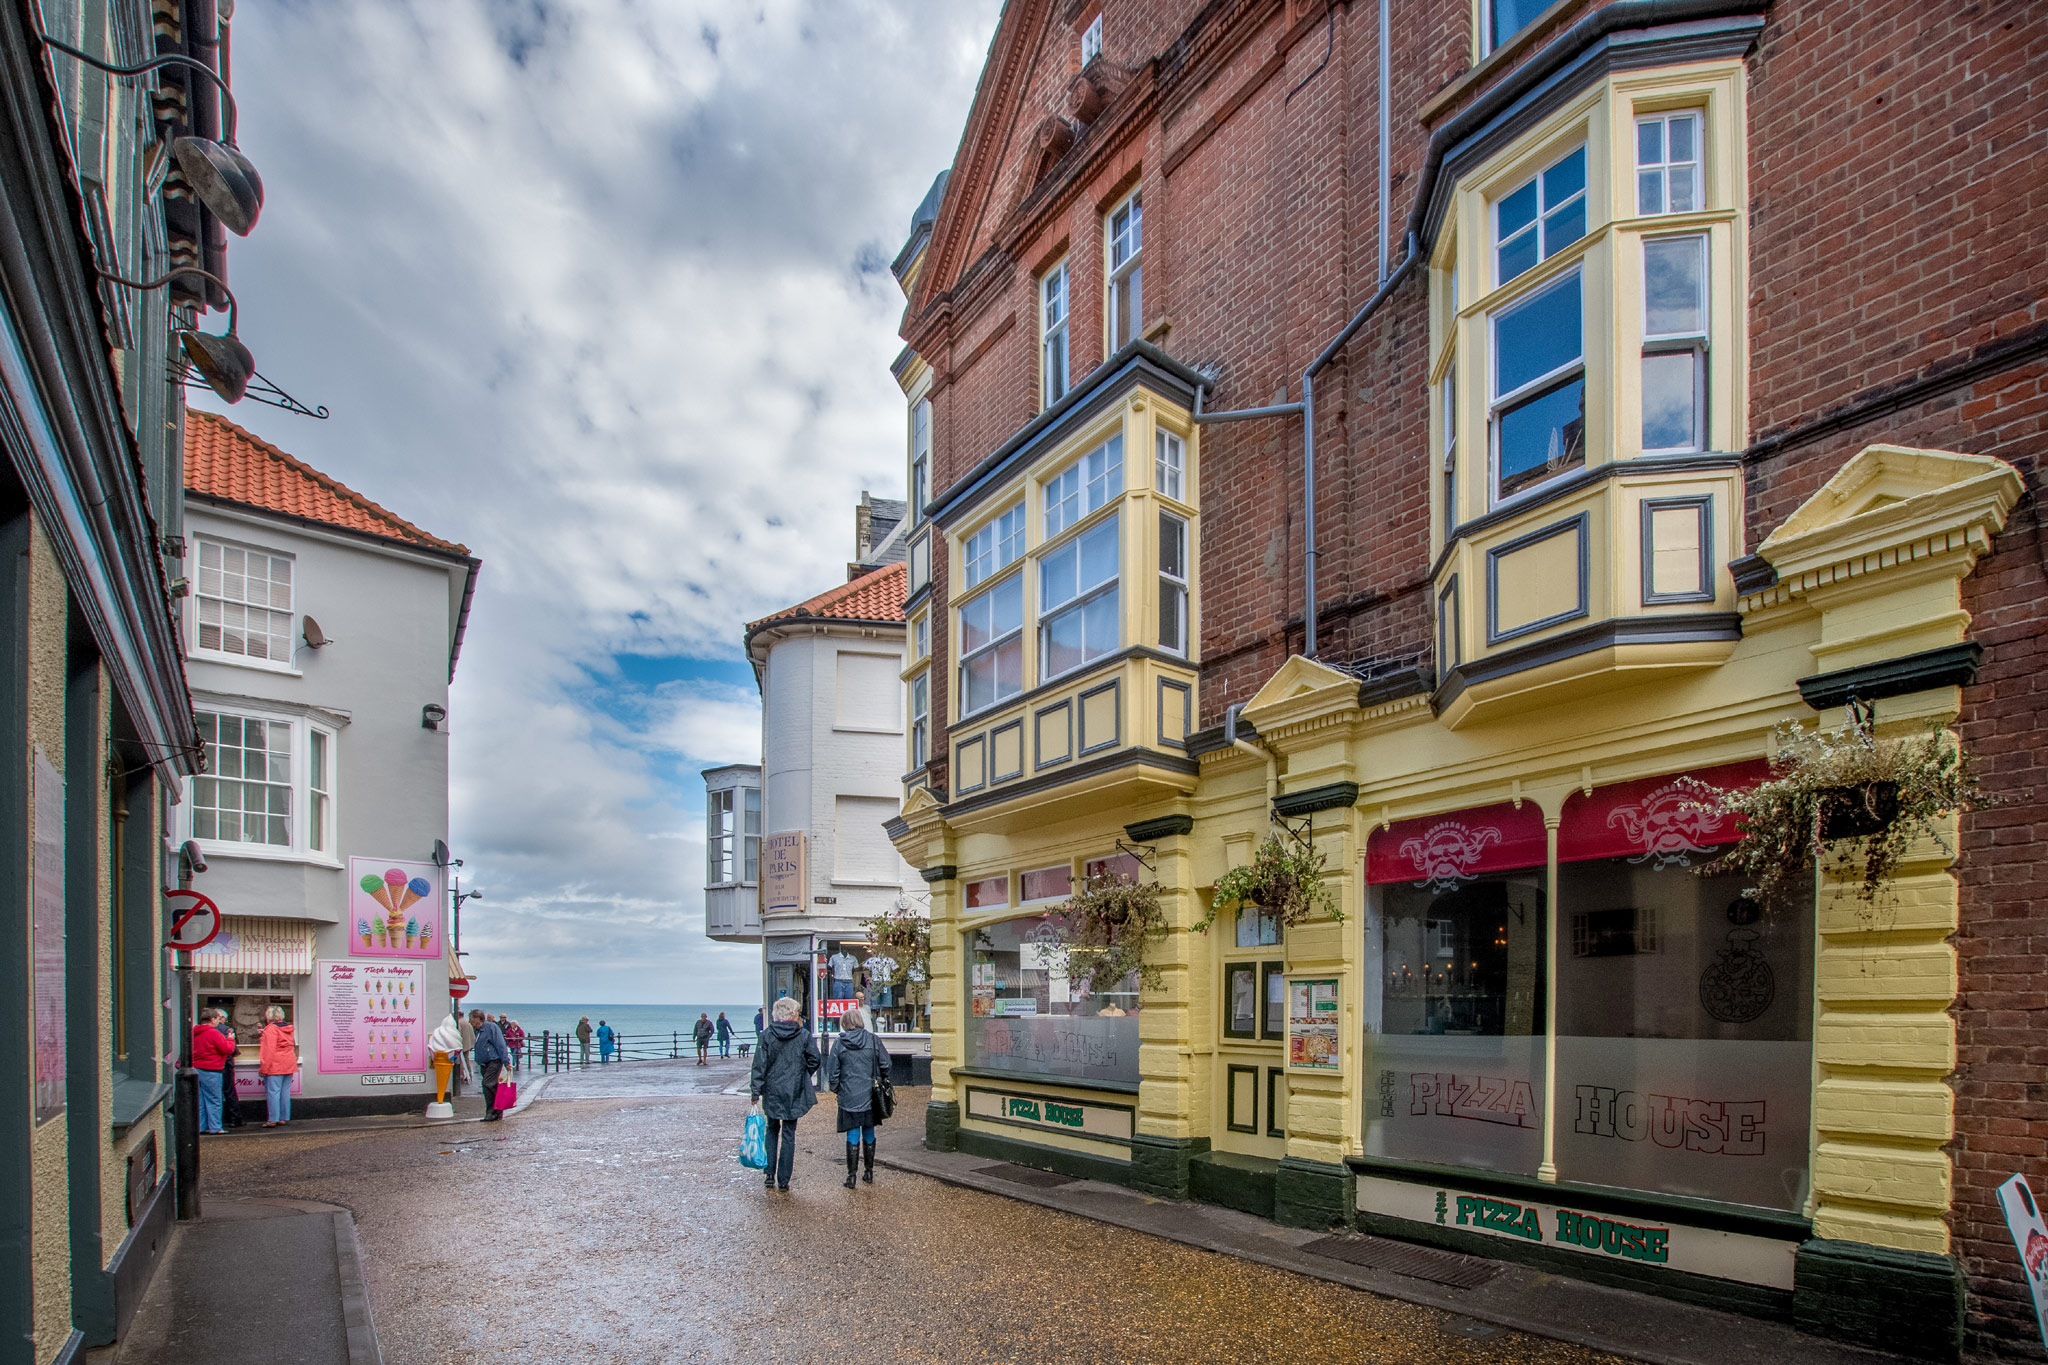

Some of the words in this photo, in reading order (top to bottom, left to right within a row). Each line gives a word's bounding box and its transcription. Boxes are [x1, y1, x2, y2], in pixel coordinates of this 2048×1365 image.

[774, 849, 786, 860] DE
[769, 861, 797, 874] PARIS
[244, 935, 305, 944] Windows
[241, 944, 261, 953] Ice
[266, 945, 307, 953] Cream
[820, 1002, 857, 1014] SALE
[389, 1075, 423, 1083] STREET
[1009, 1098, 1041, 1121] PIZZA
[1045, 1102, 1084, 1127] HOUSE
[1410, 1073, 1539, 1130] PIZZA
[1574, 1084, 1766, 1156] HOUSE
[1456, 1195, 1543, 1242] PIZZA
[1555, 1209, 1670, 1263] HOUSE
